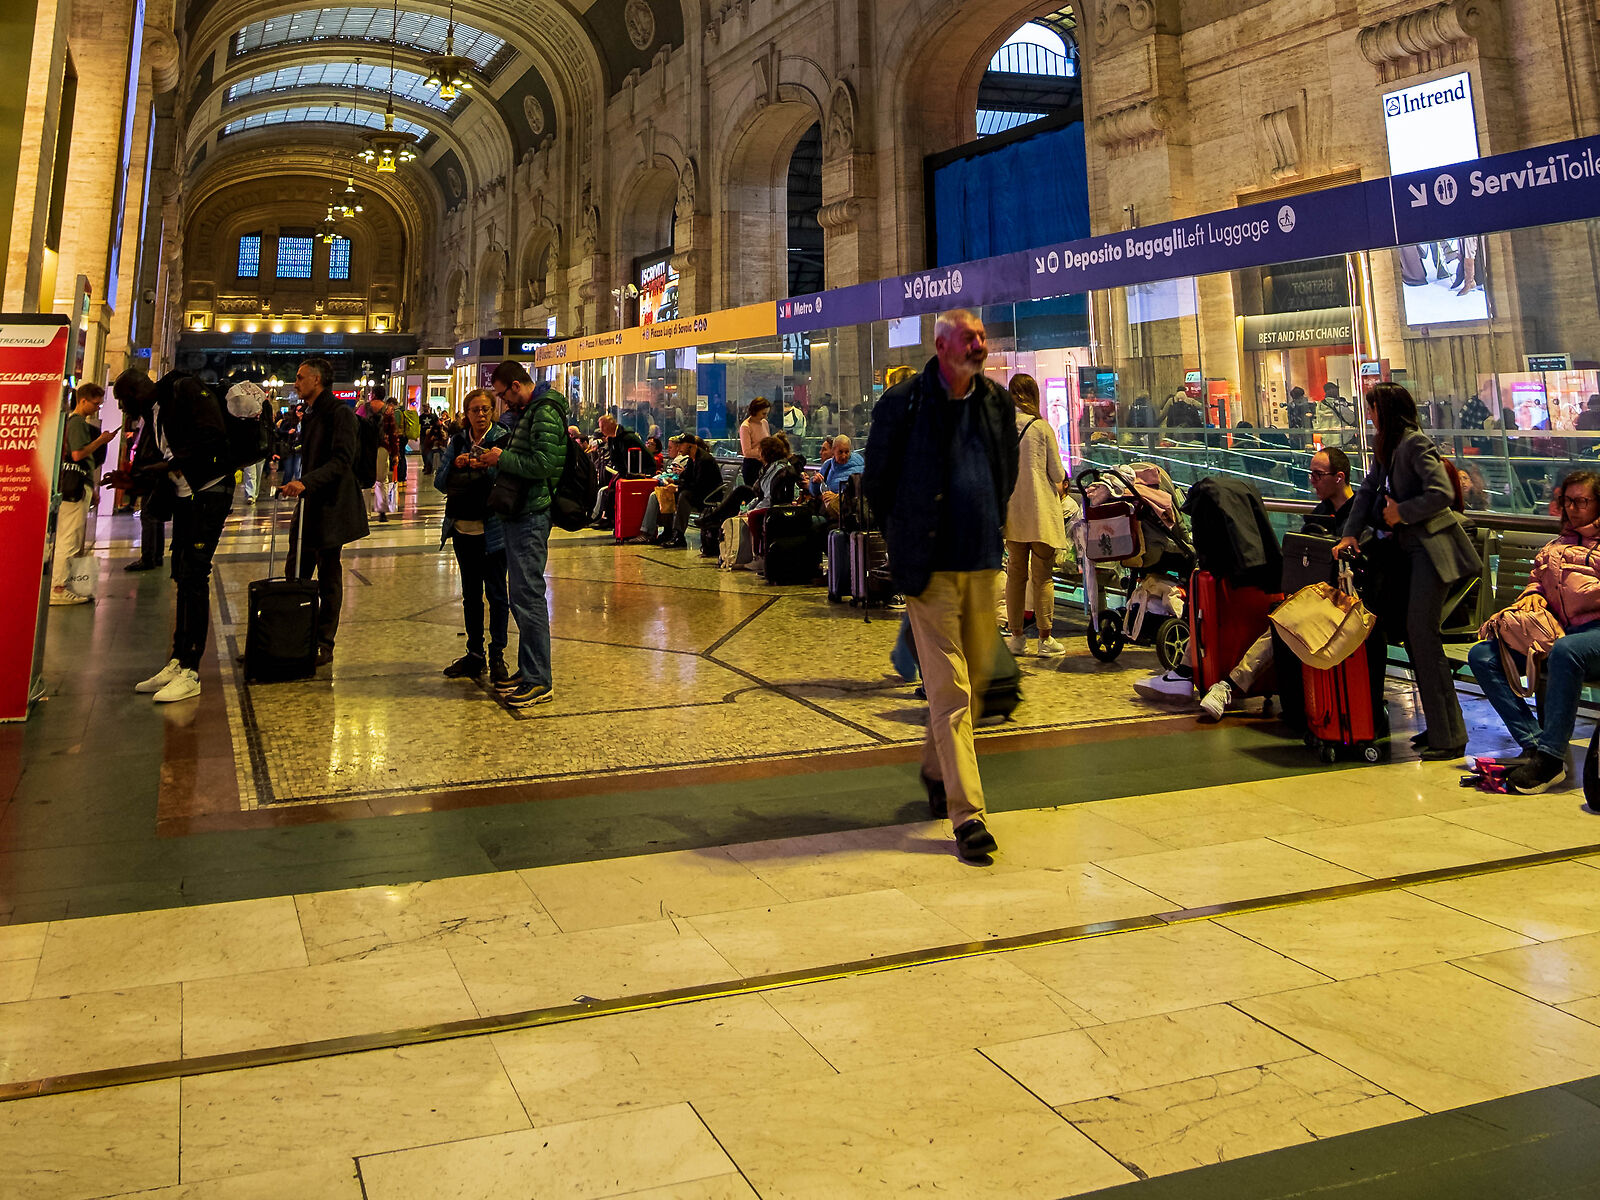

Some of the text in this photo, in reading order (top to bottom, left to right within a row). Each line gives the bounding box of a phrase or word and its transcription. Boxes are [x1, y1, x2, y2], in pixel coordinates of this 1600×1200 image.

[1402, 79, 1466, 114] Intrend
[1469, 156, 1558, 197] Servizi
[1064, 218, 1269, 271] Deposito Bagagli Left Luggage
[922, 270, 953, 299] Taxi
[794, 301, 813, 316] Metro
[650, 328, 663, 338] Piazza
[1258, 326, 1350, 343] BEST AND FAST CHANGE
[1, 403, 42, 415] FIRMA
[0, 415, 40, 426] L'ALTA
[9, 493, 20, 502] da
